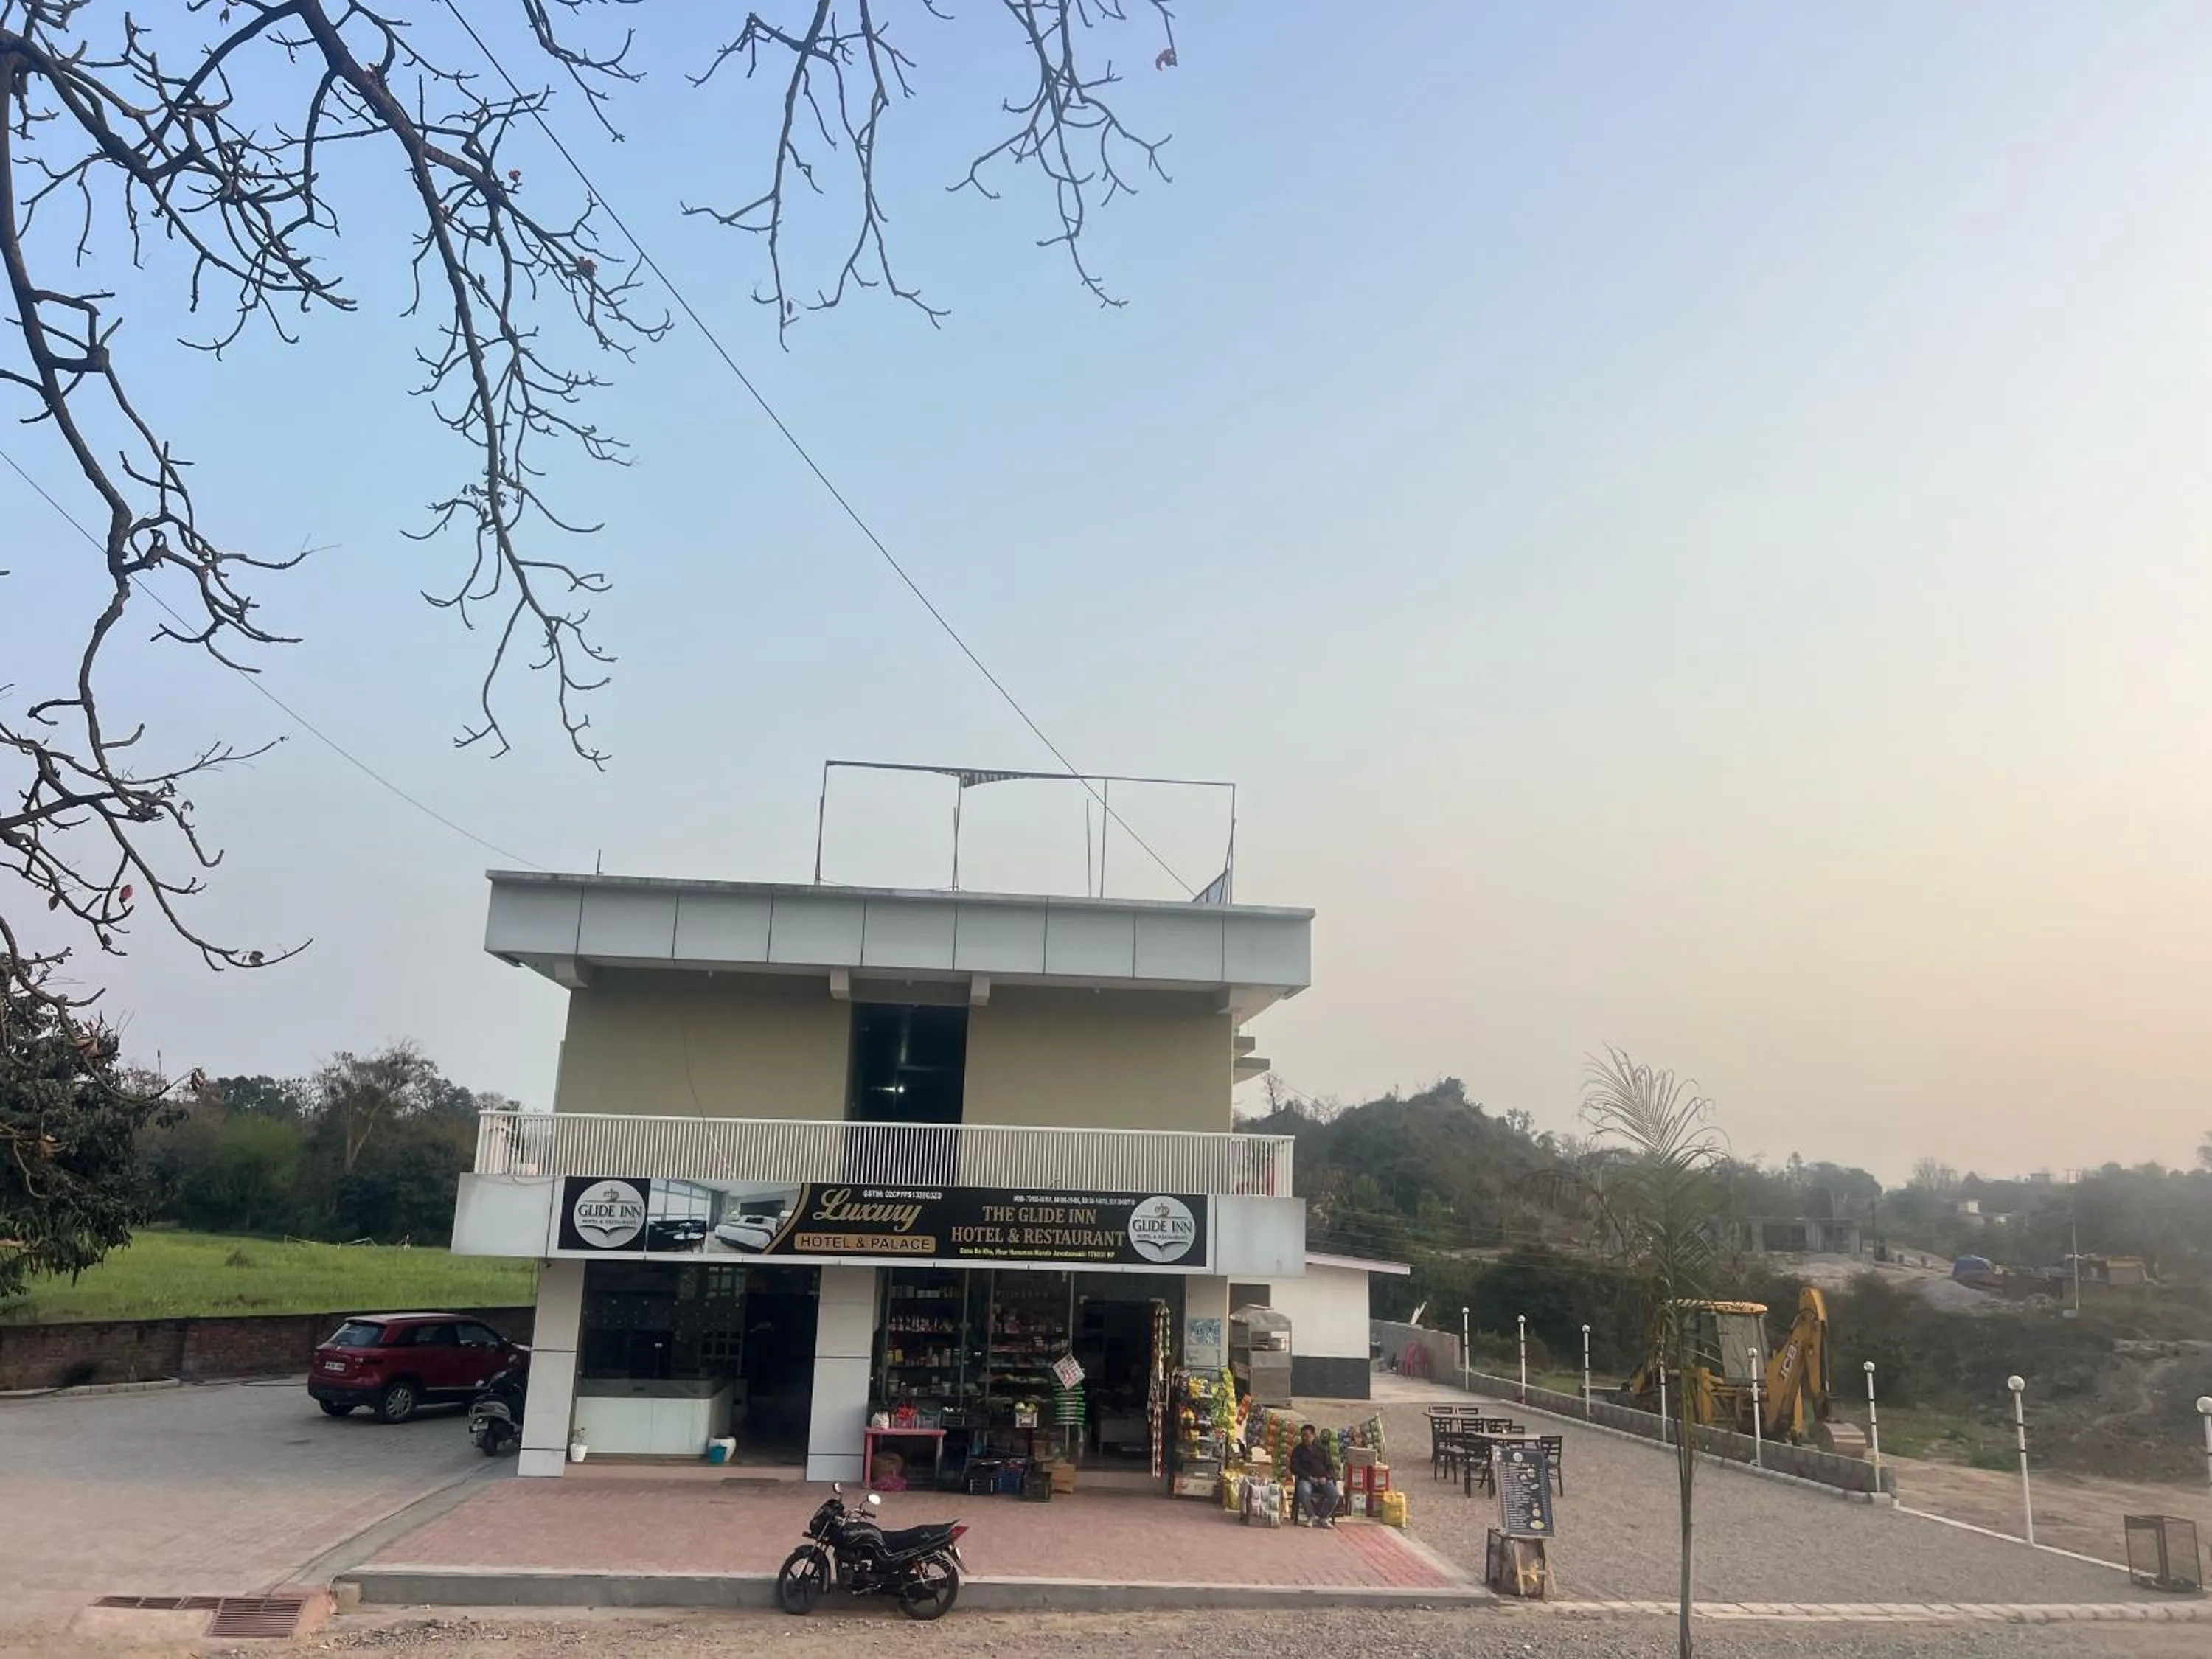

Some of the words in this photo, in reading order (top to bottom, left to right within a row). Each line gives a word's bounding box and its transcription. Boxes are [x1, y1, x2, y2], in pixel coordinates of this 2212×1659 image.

[578, 1203, 615, 1217] GLIDE
[620, 1205, 642, 1218] INN
[813, 1188, 922, 1232] Luxury
[982, 1206, 1015, 1222] THE
[1018, 1207, 1065, 1223] GLIDE
[1068, 1208, 1097, 1224] INN
[1133, 1219, 1167, 1232] GLIDE
[1172, 1220, 1193, 1234] INN
[800, 1236, 852, 1248] HOTEL
[856, 1237, 866, 1248] &
[871, 1238, 931, 1250] PALACE
[950, 1226, 1004, 1243] HOTEL
[1007, 1228, 1020, 1244] &
[1023, 1228, 1127, 1247] RESTAURANT
